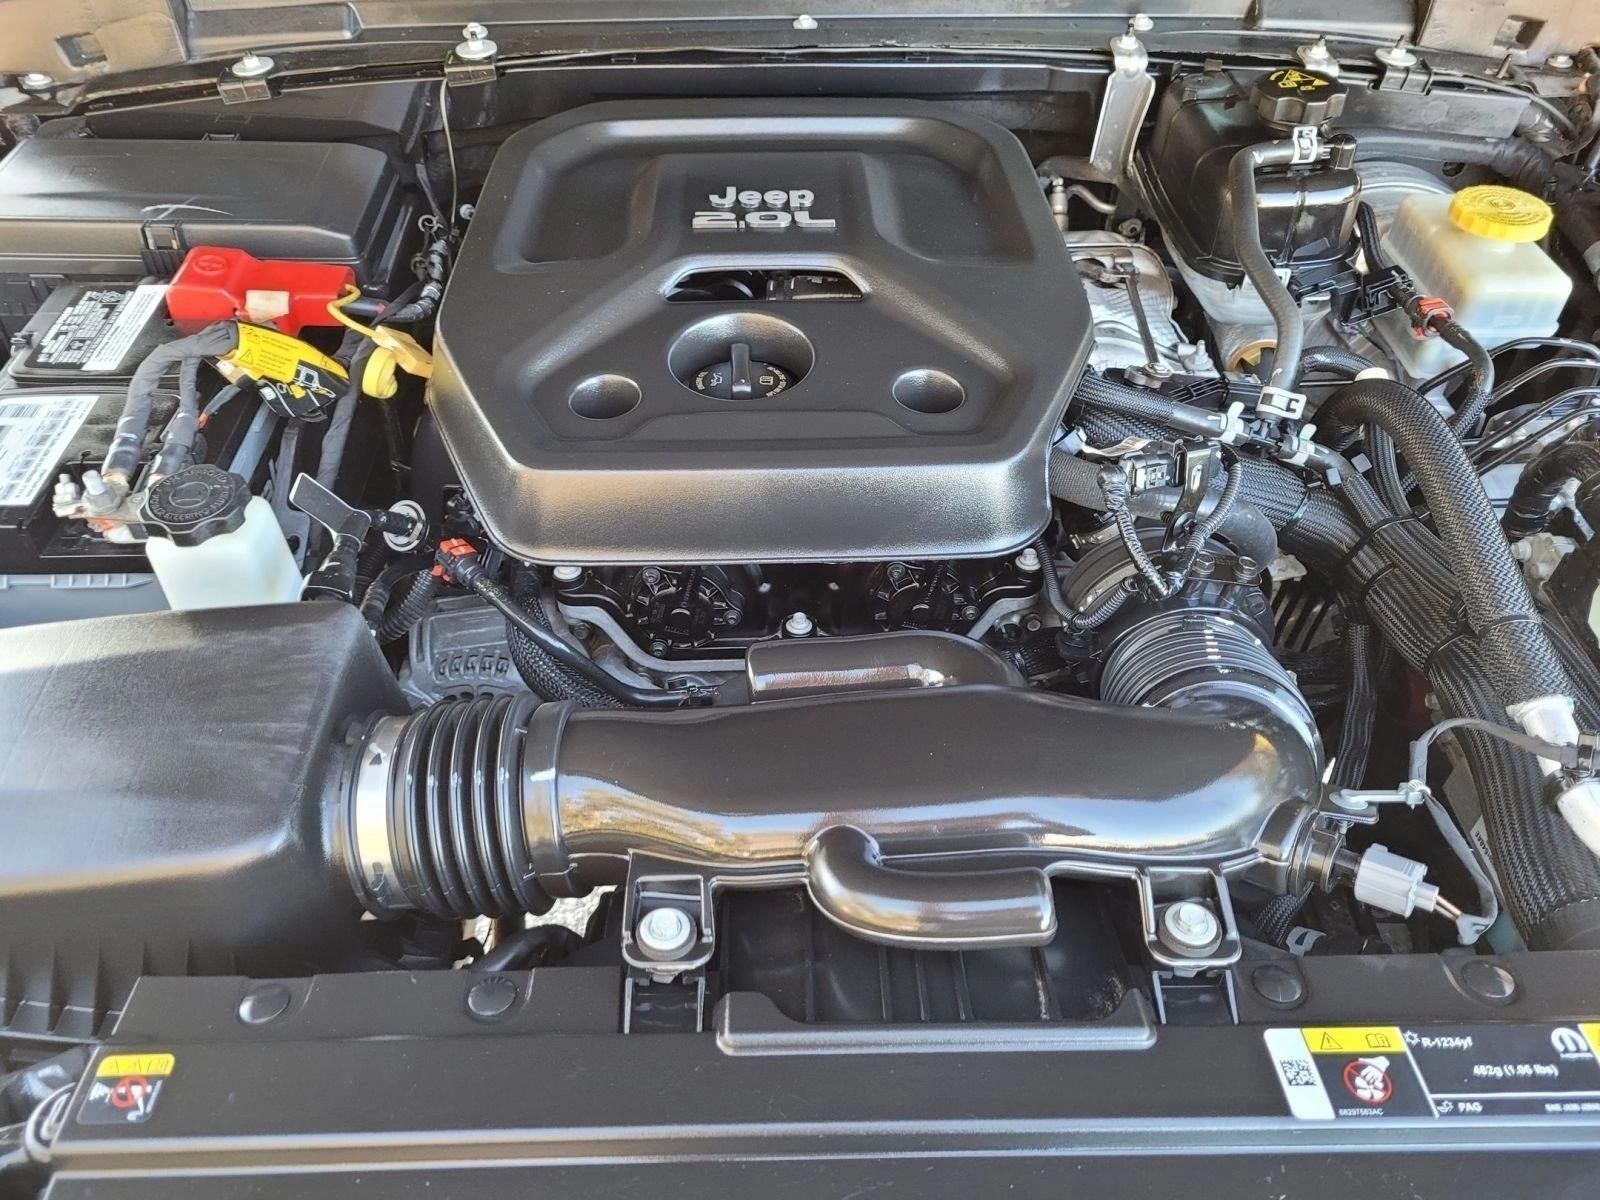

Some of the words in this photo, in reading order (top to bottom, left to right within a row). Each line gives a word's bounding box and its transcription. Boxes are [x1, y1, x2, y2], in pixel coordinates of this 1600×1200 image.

[709, 186, 815, 211] Jeep
[692, 210, 836, 229] 2.0L
[1421, 1035, 1473, 1050] R-1234yf
[1534, 1064, 1560, 1080] lbs)
[1457, 1102, 1483, 1112] PAG
